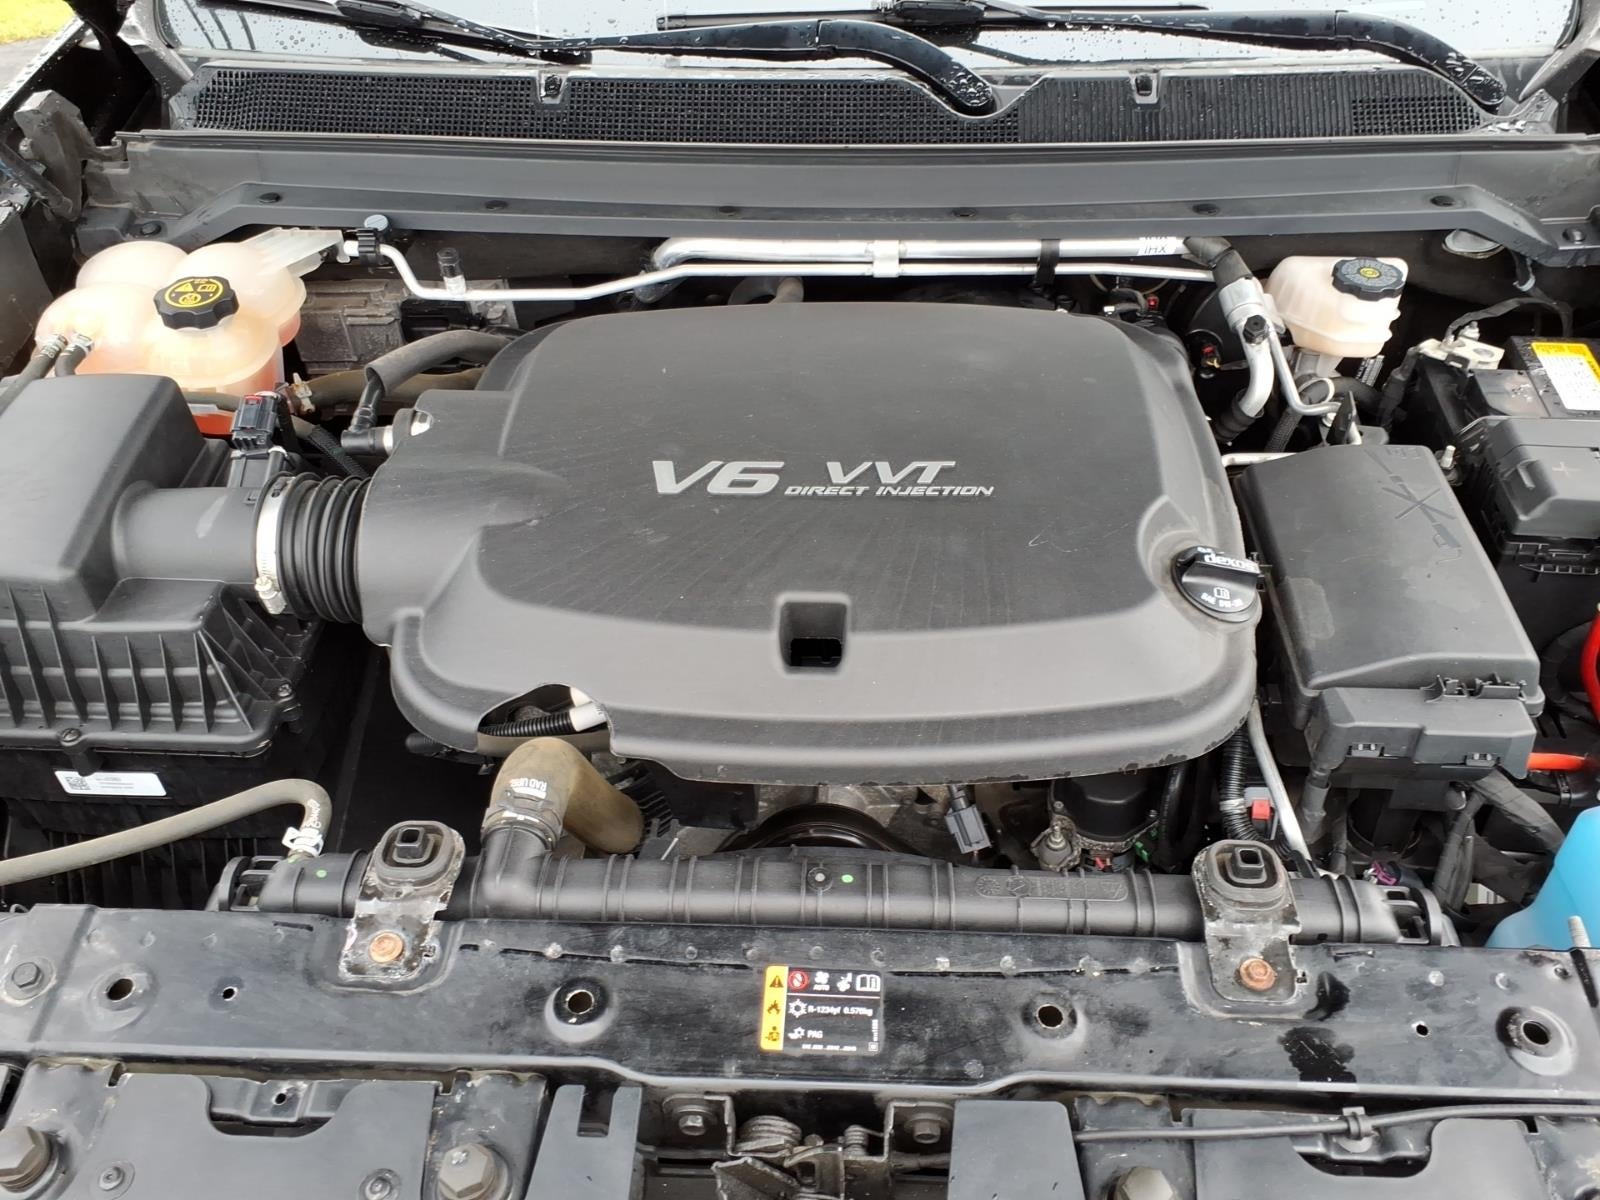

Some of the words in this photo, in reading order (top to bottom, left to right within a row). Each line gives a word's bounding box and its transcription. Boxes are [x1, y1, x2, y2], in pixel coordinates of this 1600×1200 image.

[652, 461, 785, 494] V6
[826, 461, 956, 484] VVT
[784, 486, 870, 497] DIRECT
[875, 486, 995, 497] INJECTION
[529, 778, 547, 792] RAD
[807, 1030, 823, 1039] PAG
